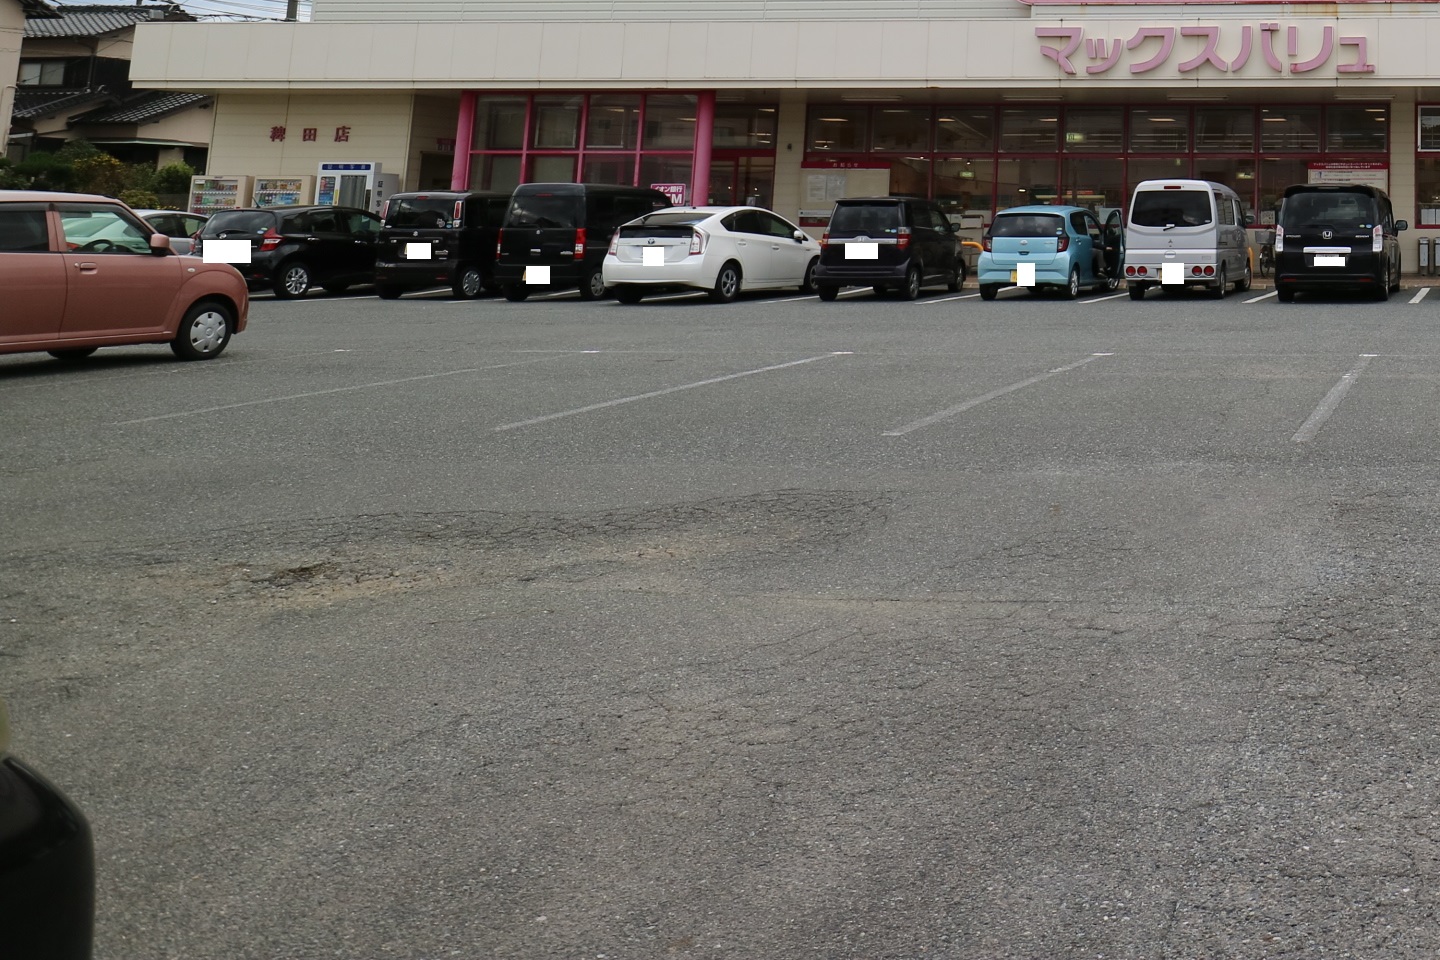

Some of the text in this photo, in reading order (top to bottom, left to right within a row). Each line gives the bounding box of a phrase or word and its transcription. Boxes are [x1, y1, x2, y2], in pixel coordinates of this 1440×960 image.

[1035, 23, 1376, 75] マックスバリュ
